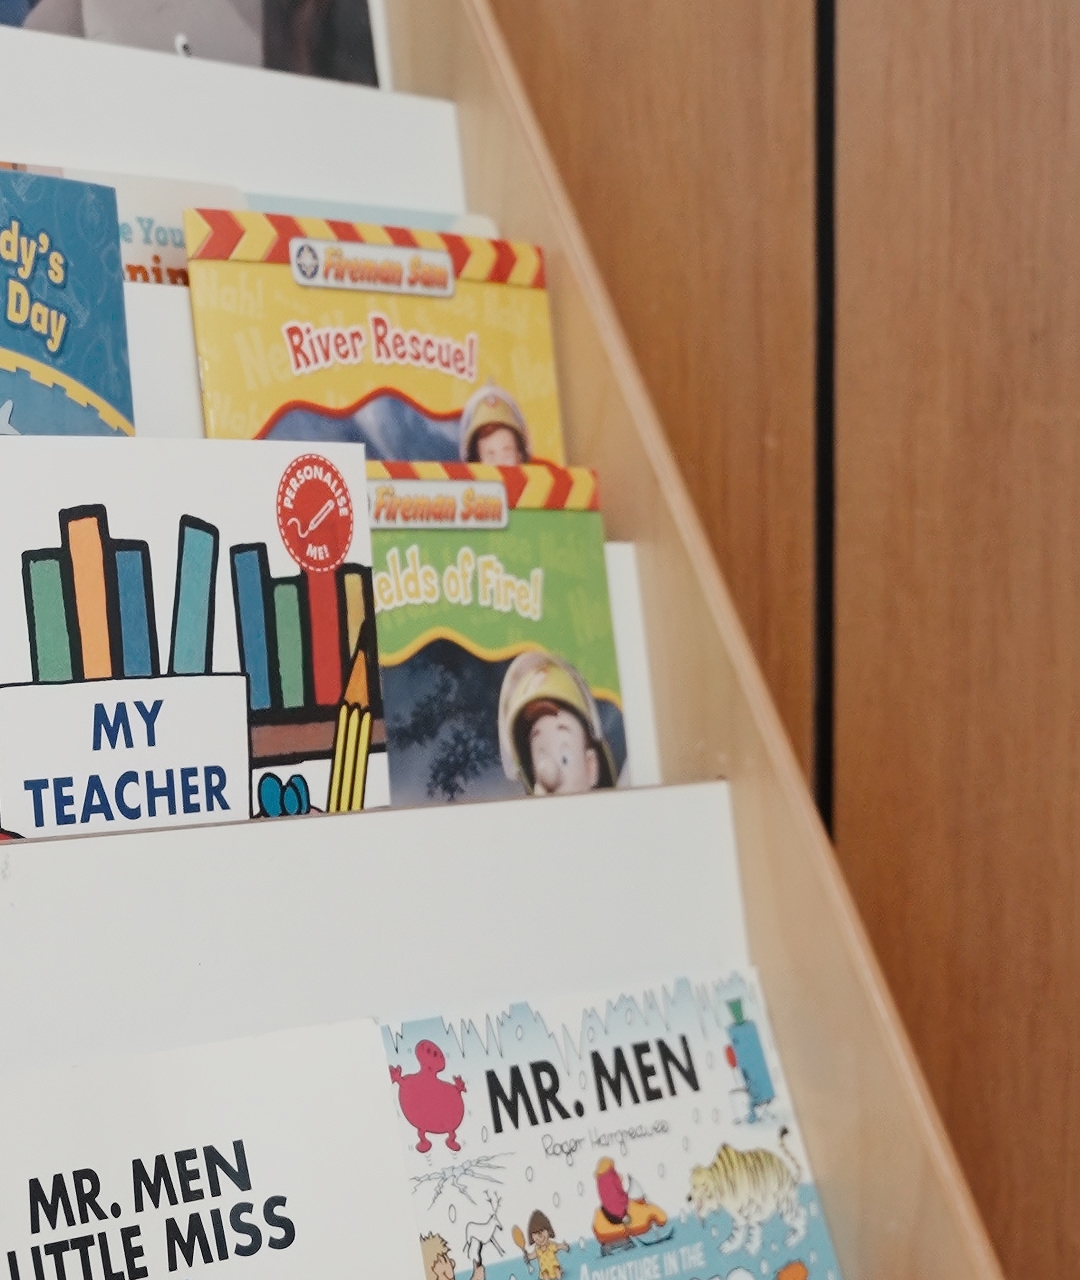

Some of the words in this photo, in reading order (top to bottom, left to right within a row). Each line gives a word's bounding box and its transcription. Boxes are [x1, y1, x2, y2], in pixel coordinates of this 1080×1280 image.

[322, 247, 404, 288] Fireman
[407, 256, 450, 290] Sam
[7, 282, 68, 354] Day
[282, 320, 367, 375] River
[369, 311, 479, 382] Rescue!
[284, 465, 349, 517] PERSONALISE
[374, 486, 456, 523] Fireman
[461, 487, 503, 523] Sam
[306, 543, 330, 560] ME!
[443, 546, 476, 606] of
[476, 554, 543, 621] Fire!
[91, 699, 164, 752] MY
[23, 765, 231, 829] TEACHER
[484, 1059, 585, 1136] MR.
[590, 1034, 700, 1112] MEN
[28, 1167, 122, 1234] MR.
[132, 1139, 252, 1213] MEN
[165, 1195, 296, 1273] MISS
[663, 1249, 679, 1276] IN
[680, 1241, 707, 1271] THE
